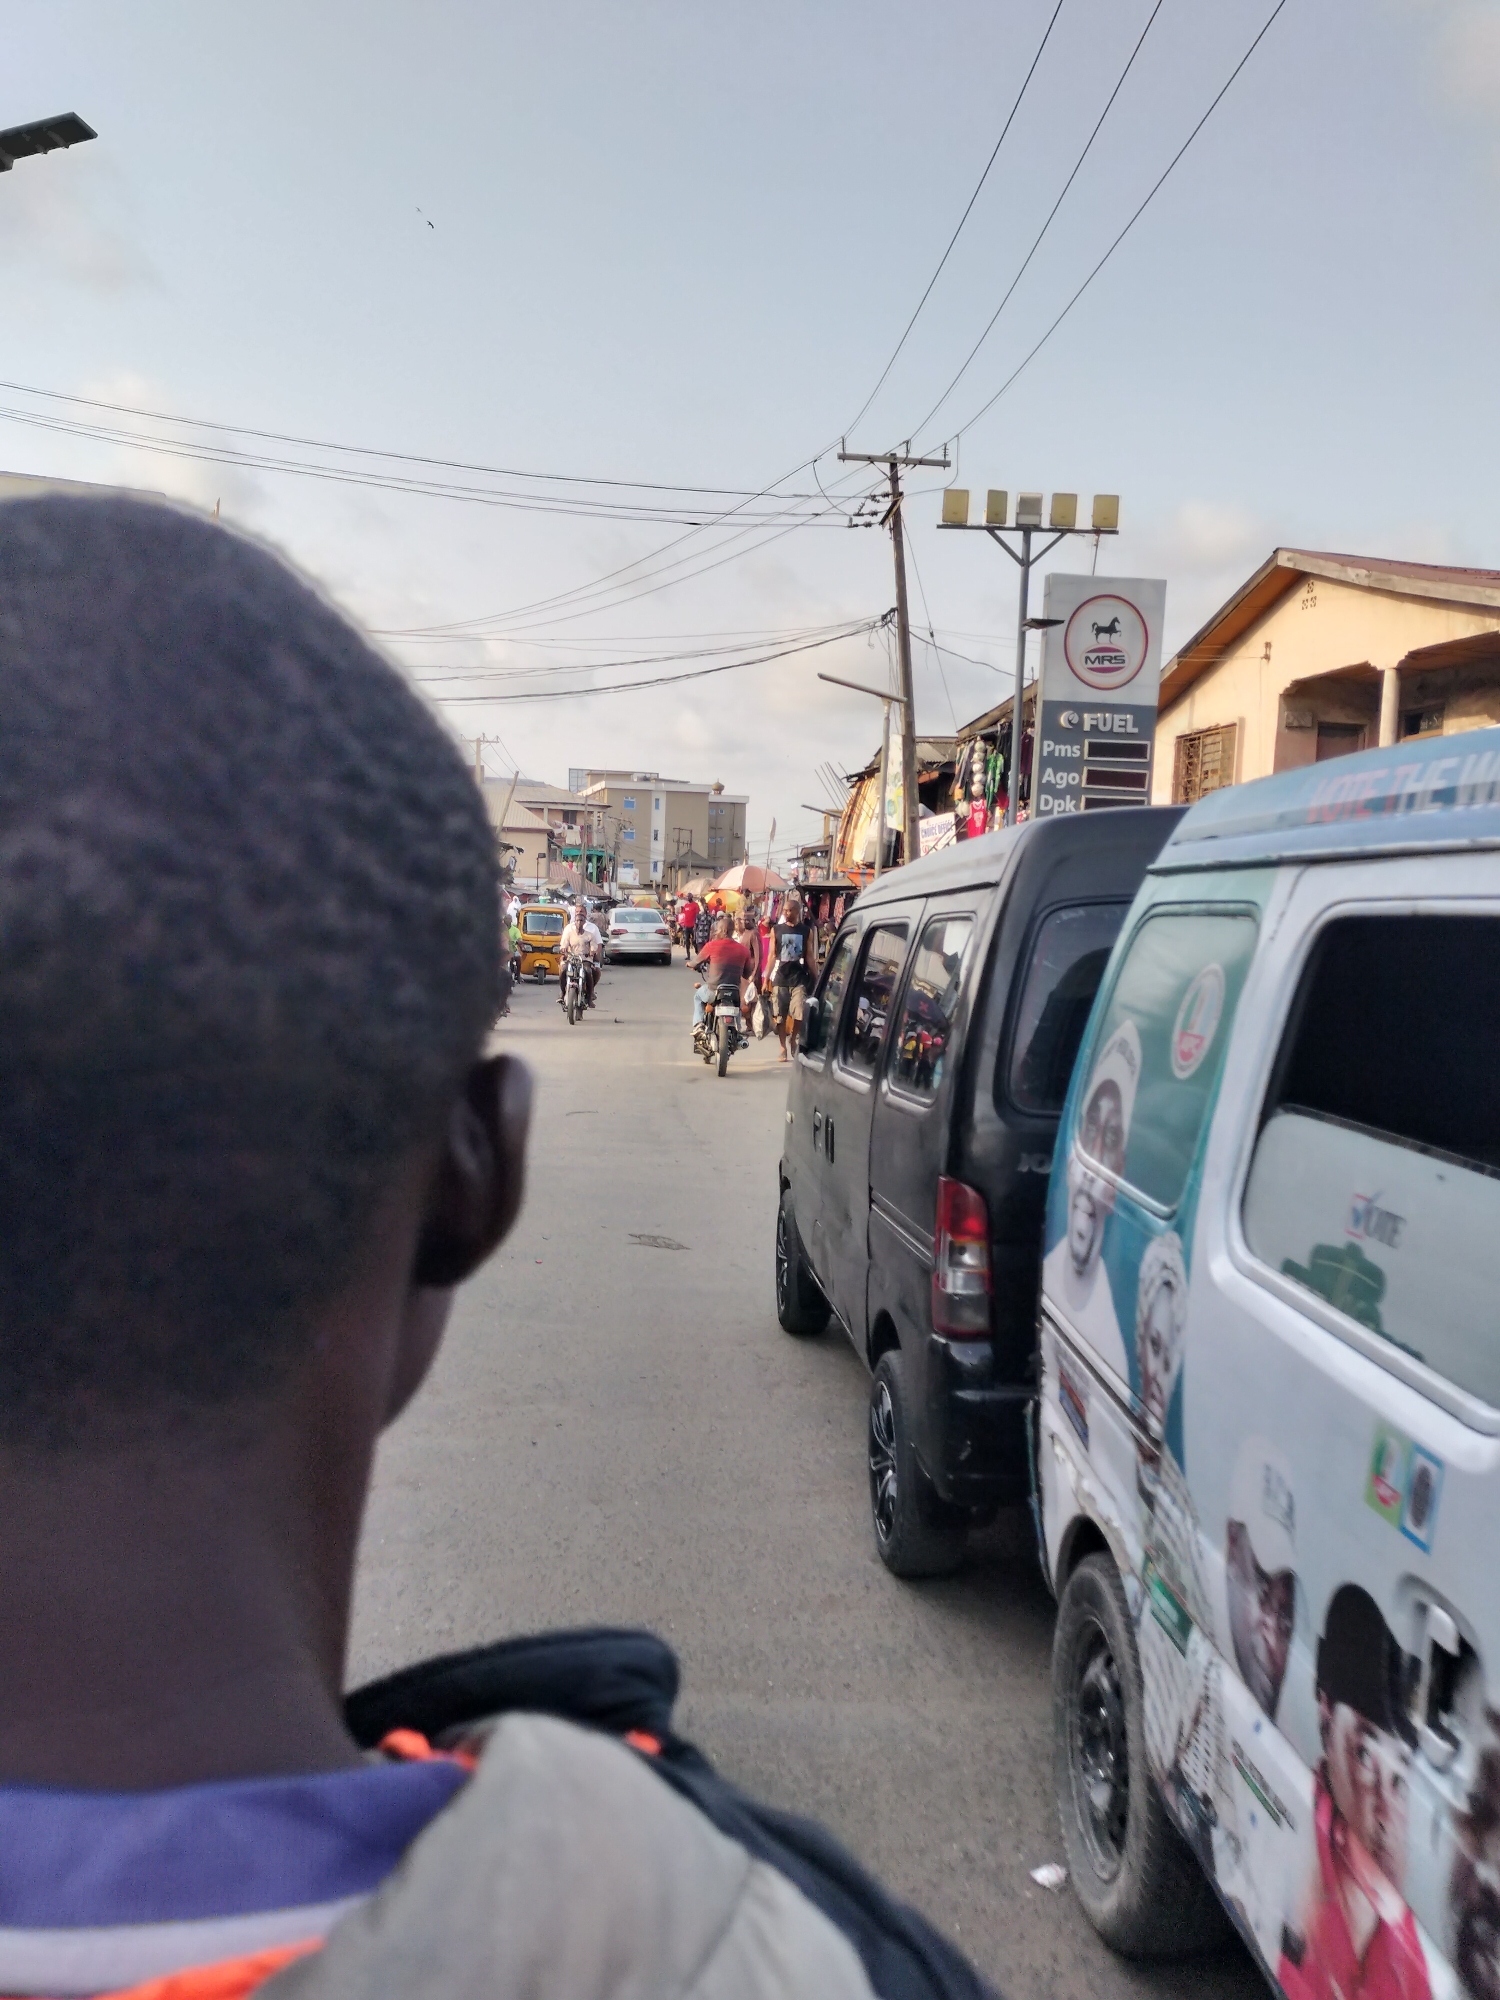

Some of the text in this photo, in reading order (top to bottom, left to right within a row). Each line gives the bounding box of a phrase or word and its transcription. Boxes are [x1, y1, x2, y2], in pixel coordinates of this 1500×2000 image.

[1084, 655, 1126, 665] MRS
[1083, 713, 1139, 733] FUEL
[1042, 740, 1081, 757] Pms
[1041, 767, 1080, 789] Ago
[1307, 768, 1390, 823] VOTE
[1382, 757, 1459, 816] THE
[1039, 794, 1077, 816] Dpk
